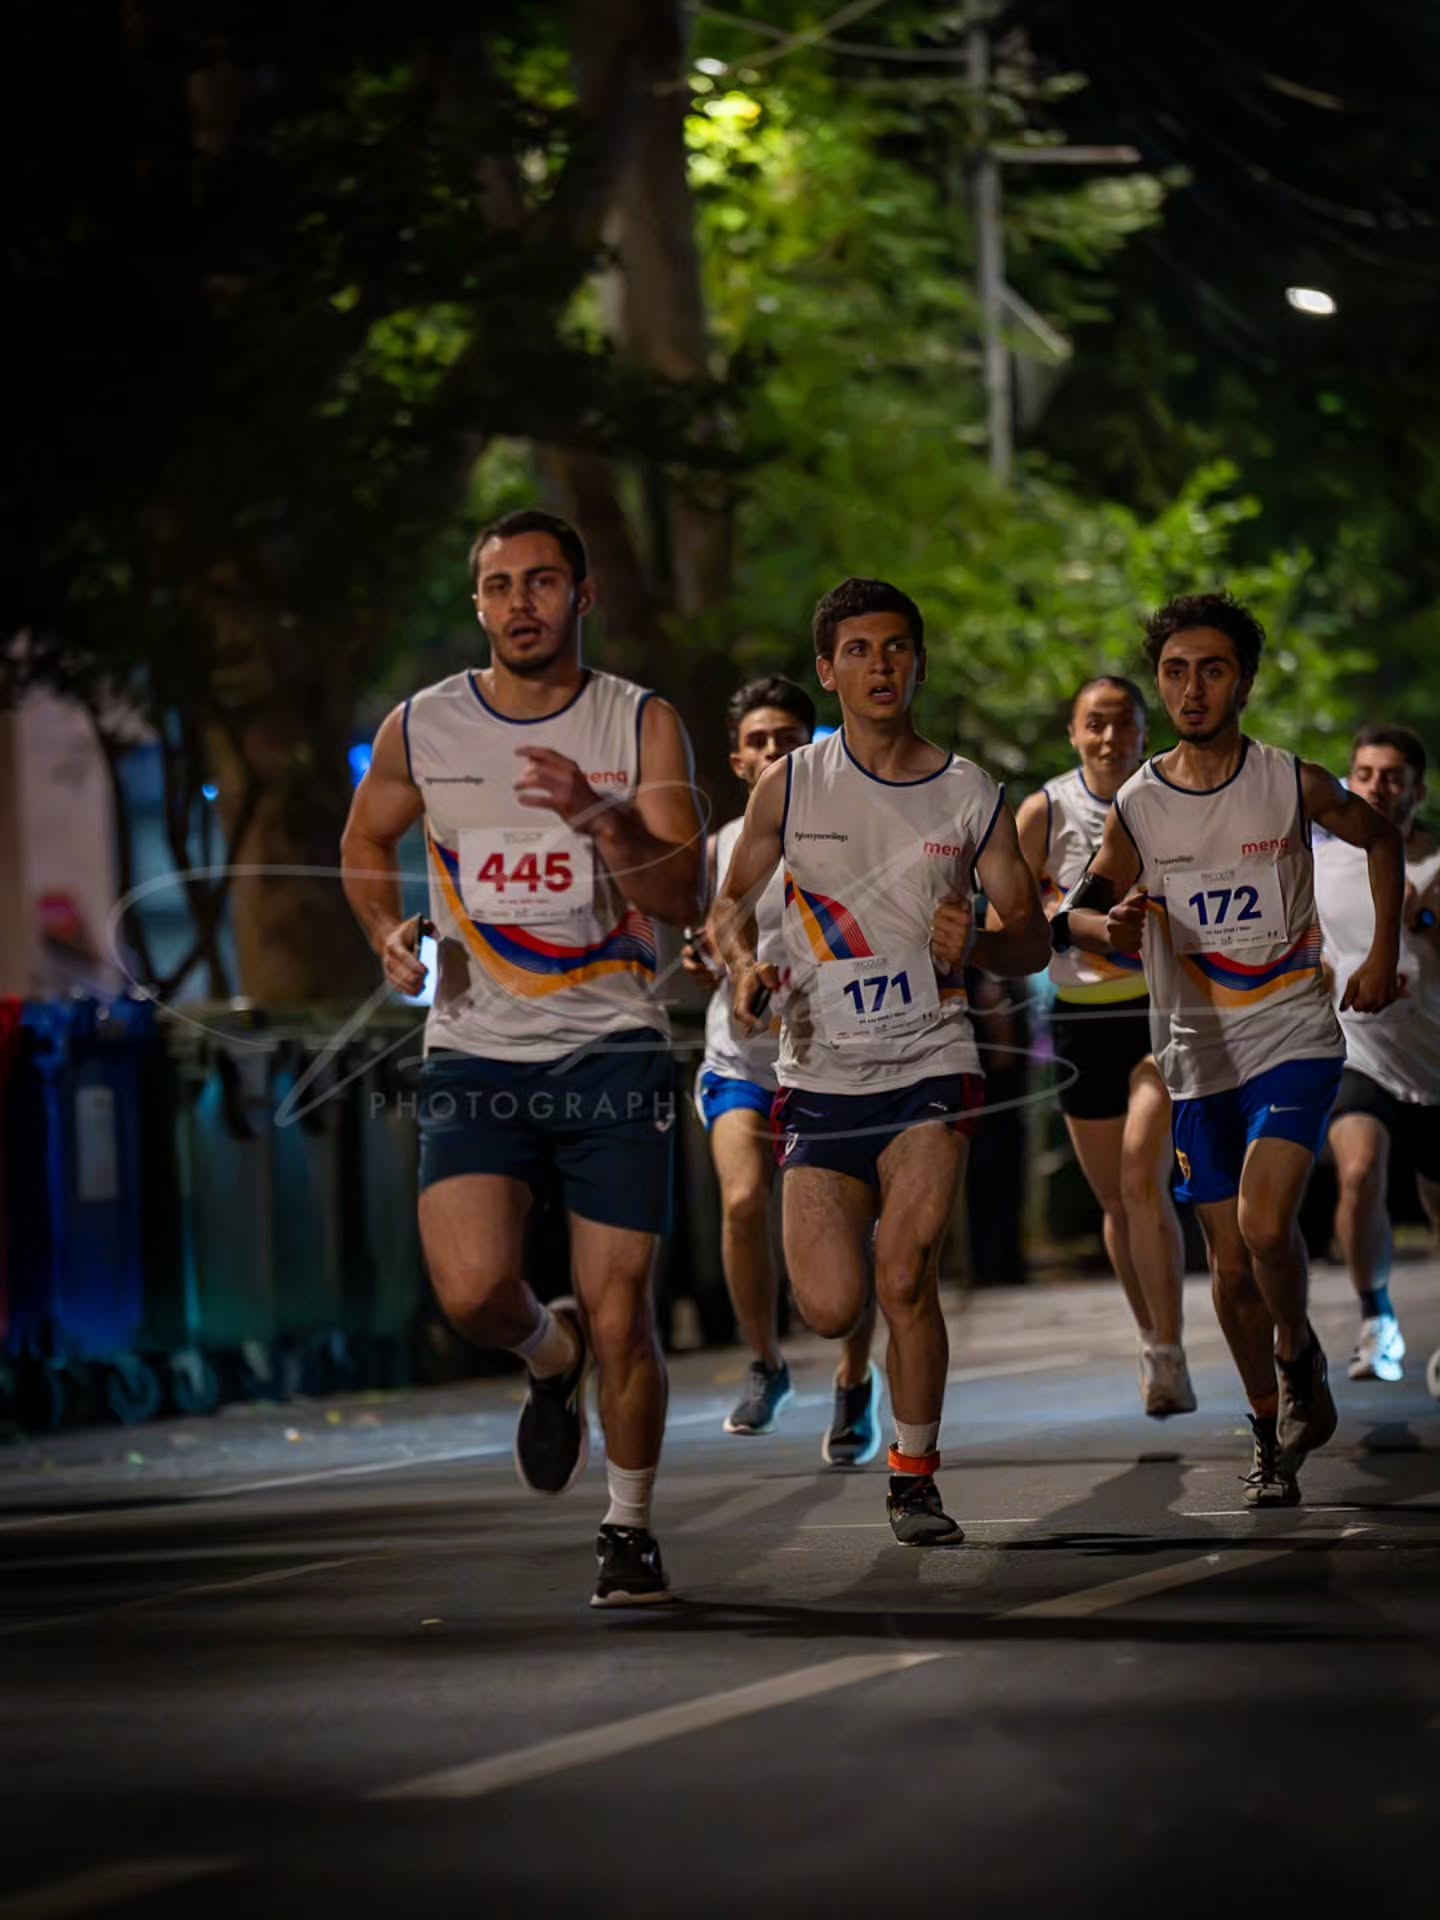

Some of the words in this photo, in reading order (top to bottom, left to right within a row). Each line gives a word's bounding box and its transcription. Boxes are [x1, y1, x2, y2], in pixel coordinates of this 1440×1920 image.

[477, 853, 574, 893] 445
[1189, 885, 1262, 926] 172
[843, 970, 913, 1015] 171
